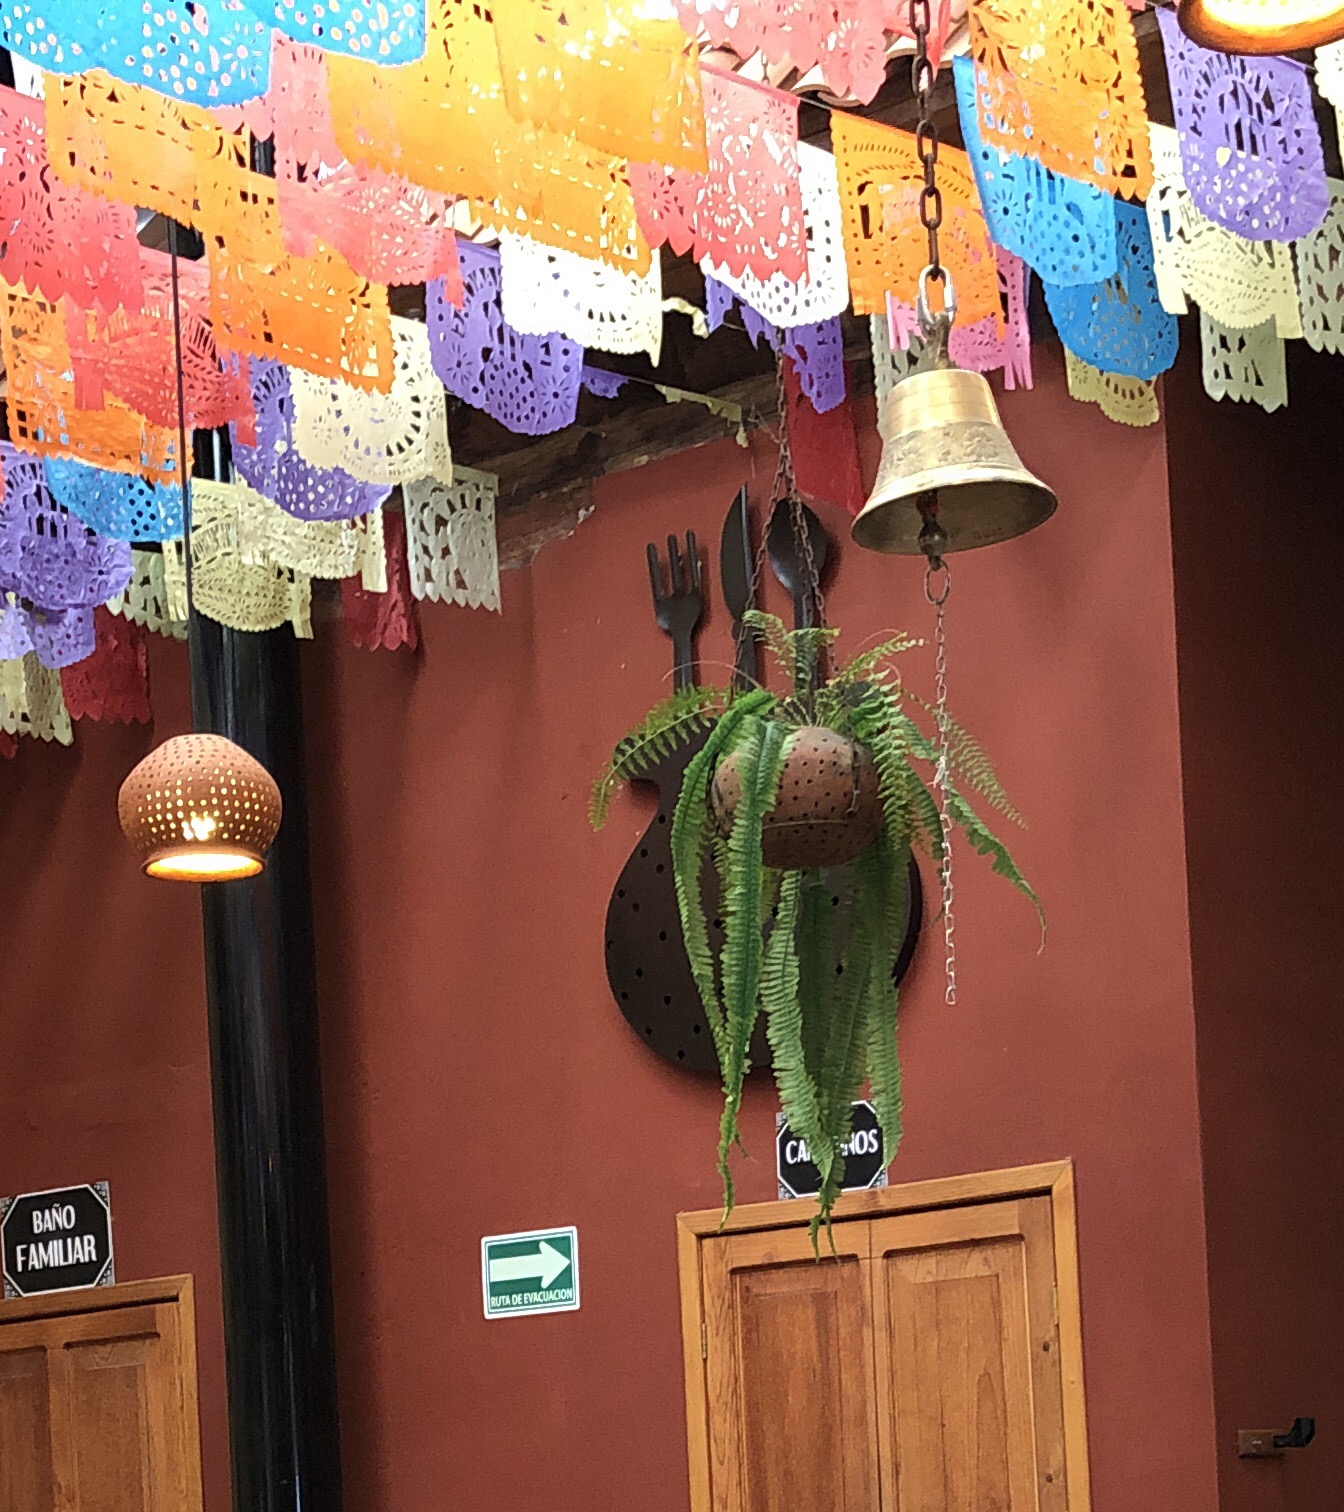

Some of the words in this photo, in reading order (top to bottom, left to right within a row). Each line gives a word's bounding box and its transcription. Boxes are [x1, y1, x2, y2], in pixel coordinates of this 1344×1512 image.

[32, 1203, 76, 1234] BAÑO
[16, 1234, 97, 1273] FAMILIAR
[491, 1295, 511, 1308] RUTA
[511, 1292, 523, 1306] DE
